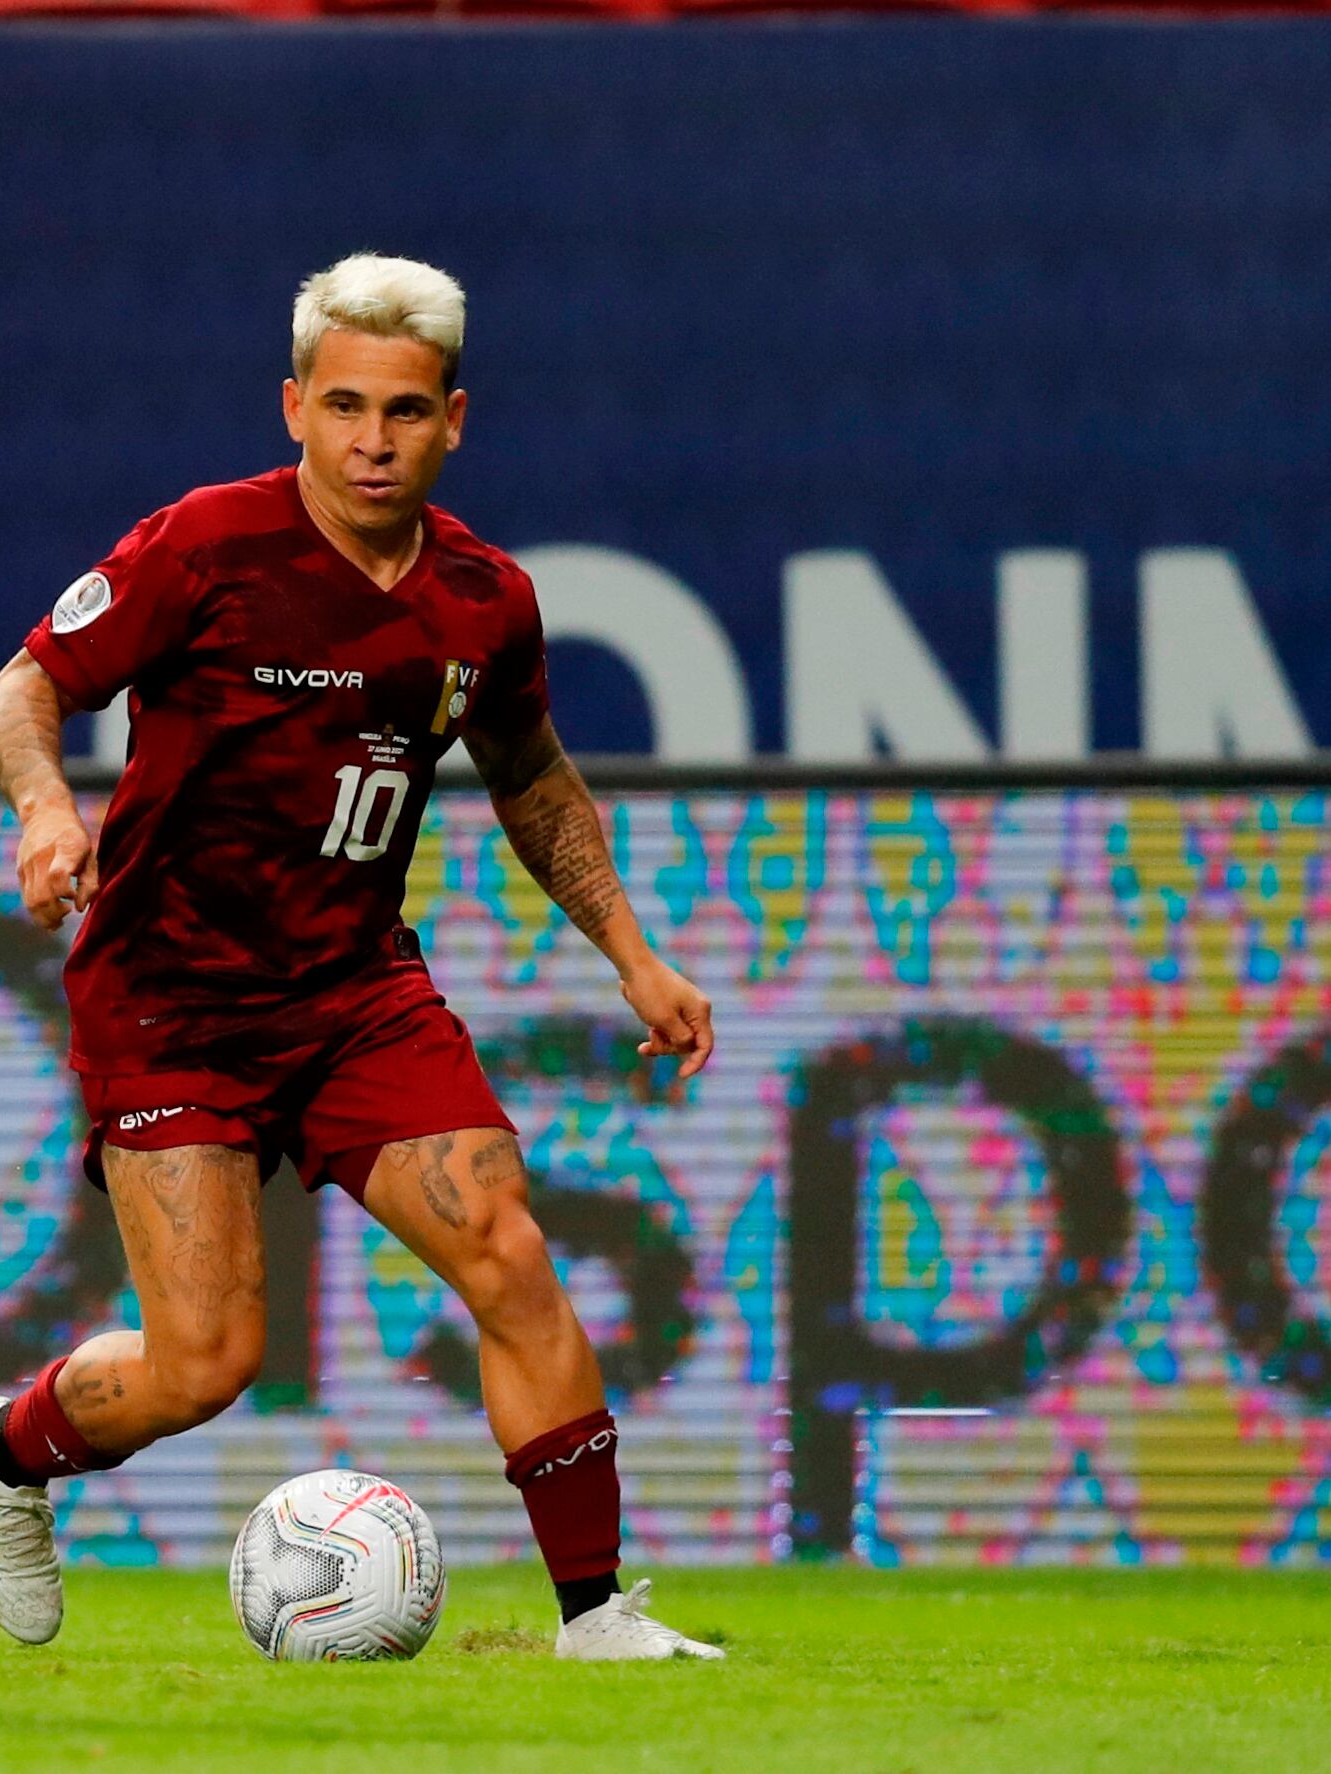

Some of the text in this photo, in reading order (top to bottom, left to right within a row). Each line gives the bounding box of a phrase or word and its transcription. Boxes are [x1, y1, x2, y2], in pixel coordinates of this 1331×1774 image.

[253, 666, 364, 689] GIVOVA
[445, 664, 480, 688] FVF
[320, 764, 411, 863] 10
